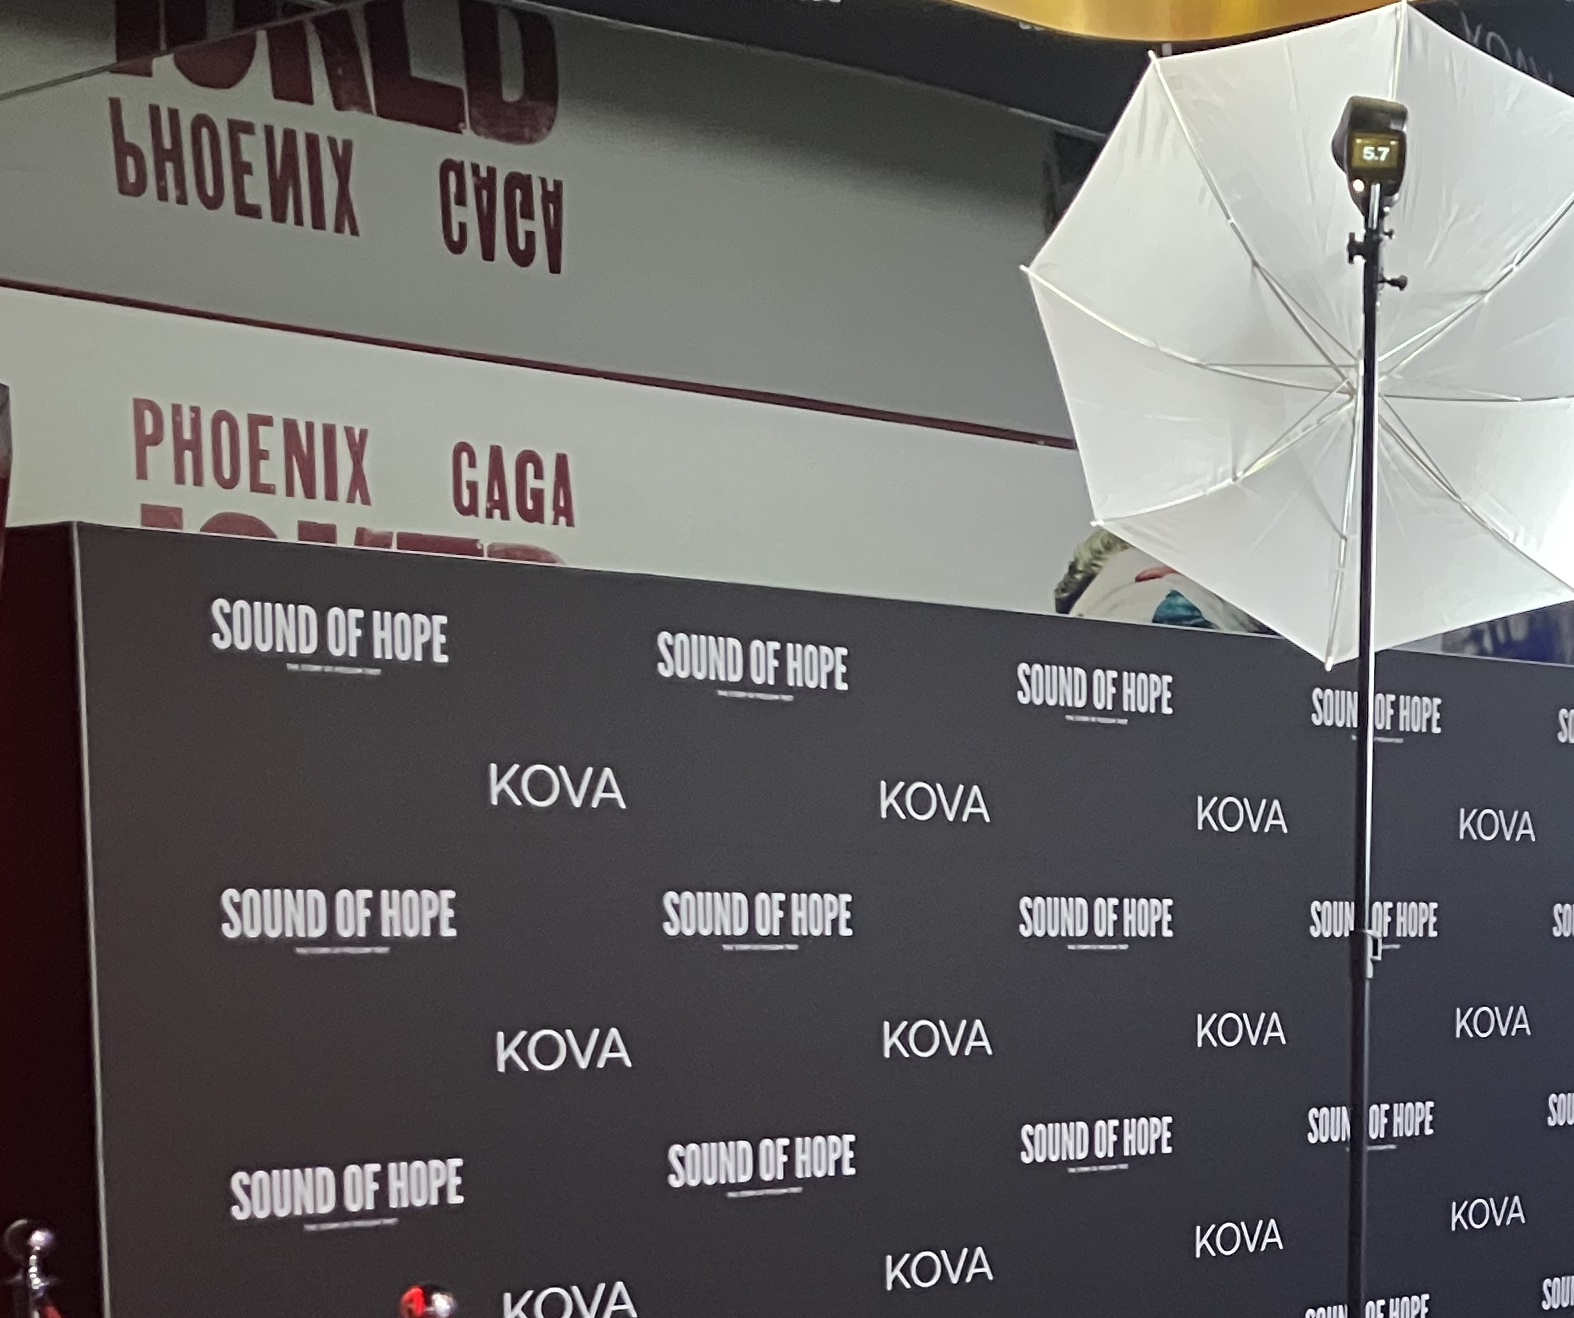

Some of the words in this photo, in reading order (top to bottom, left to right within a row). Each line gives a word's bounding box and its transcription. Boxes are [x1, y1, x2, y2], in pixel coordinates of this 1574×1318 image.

[132, 397, 372, 507] PHOENIX
[451, 441, 575, 528] GAGA
[212, 598, 318, 655] SOUND
[327, 606, 364, 657] OF
[373, 611, 449, 663] HOPE
[657, 631, 744, 682] SOUND
[749, 640, 781, 685] OF
[787, 643, 849, 691] HOPE
[1017, 662, 1087, 707] SOUND
[1093, 669, 1118, 710] OF
[1123, 672, 1173, 715] HOPE
[1311, 687, 1359, 728] SOUN
[1374, 693, 1397, 730] OF
[1399, 695, 1442, 733] HOPE
[489, 762, 627, 809] KOVA
[880, 780, 991, 823] KOVA
[1197, 795, 1288, 834] KOVA
[1459, 807, 1536, 842] KOVA
[221, 888, 327, 939] SOUND
[335, 888, 373, 938] OF
[380, 889, 457, 938] HOPE
[662, 890, 749, 937] SOUND
[755, 892, 786, 937] OF
[791, 893, 853, 937] HOPE
[1019, 896, 1089, 938] SOUND
[1094, 897, 1119, 938] OF
[1124, 897, 1174, 938] HOPE
[1309, 900, 1355, 938] SOUN
[1371, 901, 1394, 938] OF
[1396, 901, 1439, 938] HOPE
[883, 1019, 993, 1059] KOVA
[1197, 1011, 1287, 1048] KOVA
[1455, 1005, 1532, 1038] KOVA
[496, 1027, 632, 1073] KOVA
[1020, 1121, 1089, 1164] SOUND
[1094, 1119, 1120, 1159] OF
[1124, 1116, 1173, 1157] HOPE
[1307, 1105, 1350, 1144] SOUN
[1368, 1103, 1390, 1139] OF
[1393, 1101, 1435, 1138] HOPE
[668, 1140, 754, 1188] SOUND
[759, 1137, 790, 1182] OF
[795, 1134, 856, 1179] HOPE
[230, 1166, 336, 1221] SOUND
[343, 1163, 382, 1213] OF
[388, 1158, 465, 1209] HOPE
[1451, 1195, 1526, 1232] KOVA
[1195, 1218, 1284, 1259] KOVA
[886, 1246, 994, 1291] KOVA
